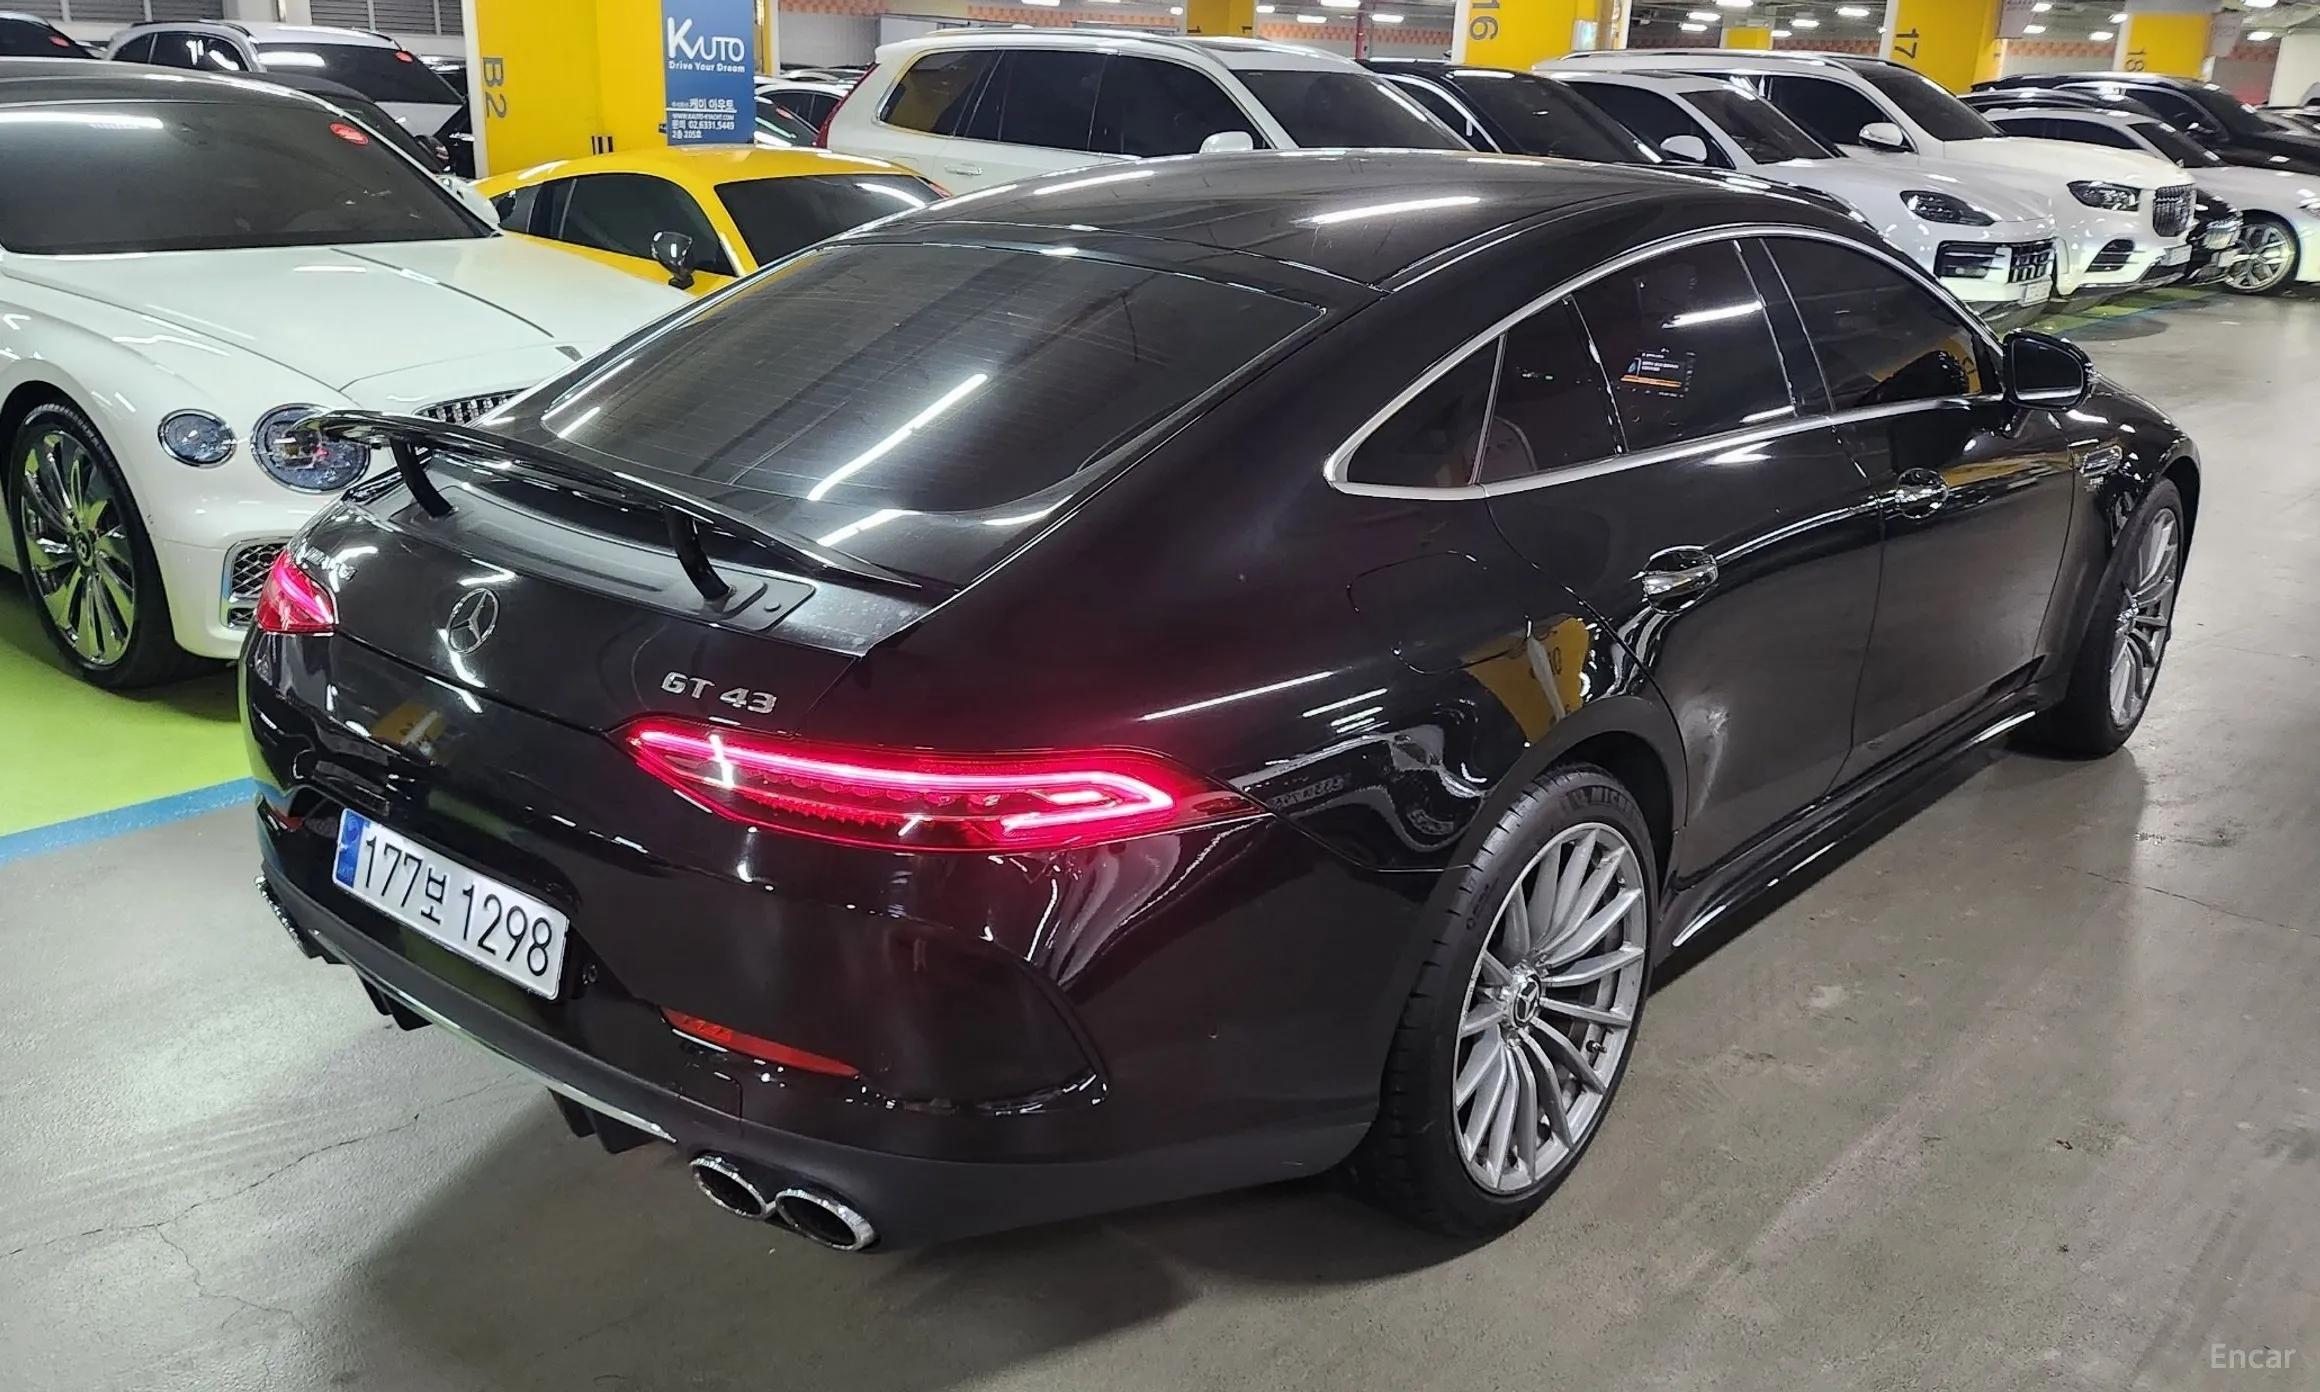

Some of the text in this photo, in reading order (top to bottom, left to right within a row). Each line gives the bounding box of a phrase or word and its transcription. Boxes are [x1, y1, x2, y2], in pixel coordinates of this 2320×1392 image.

[1470, 0, 1500, 40] 16
[1894, 28, 1920, 59] 17
[669, 60, 745, 73] Drive Your Dream
[483, 57, 507, 118] B2
[661, 671, 777, 714] GT 43
[364, 836, 554, 977] 177보 1298
